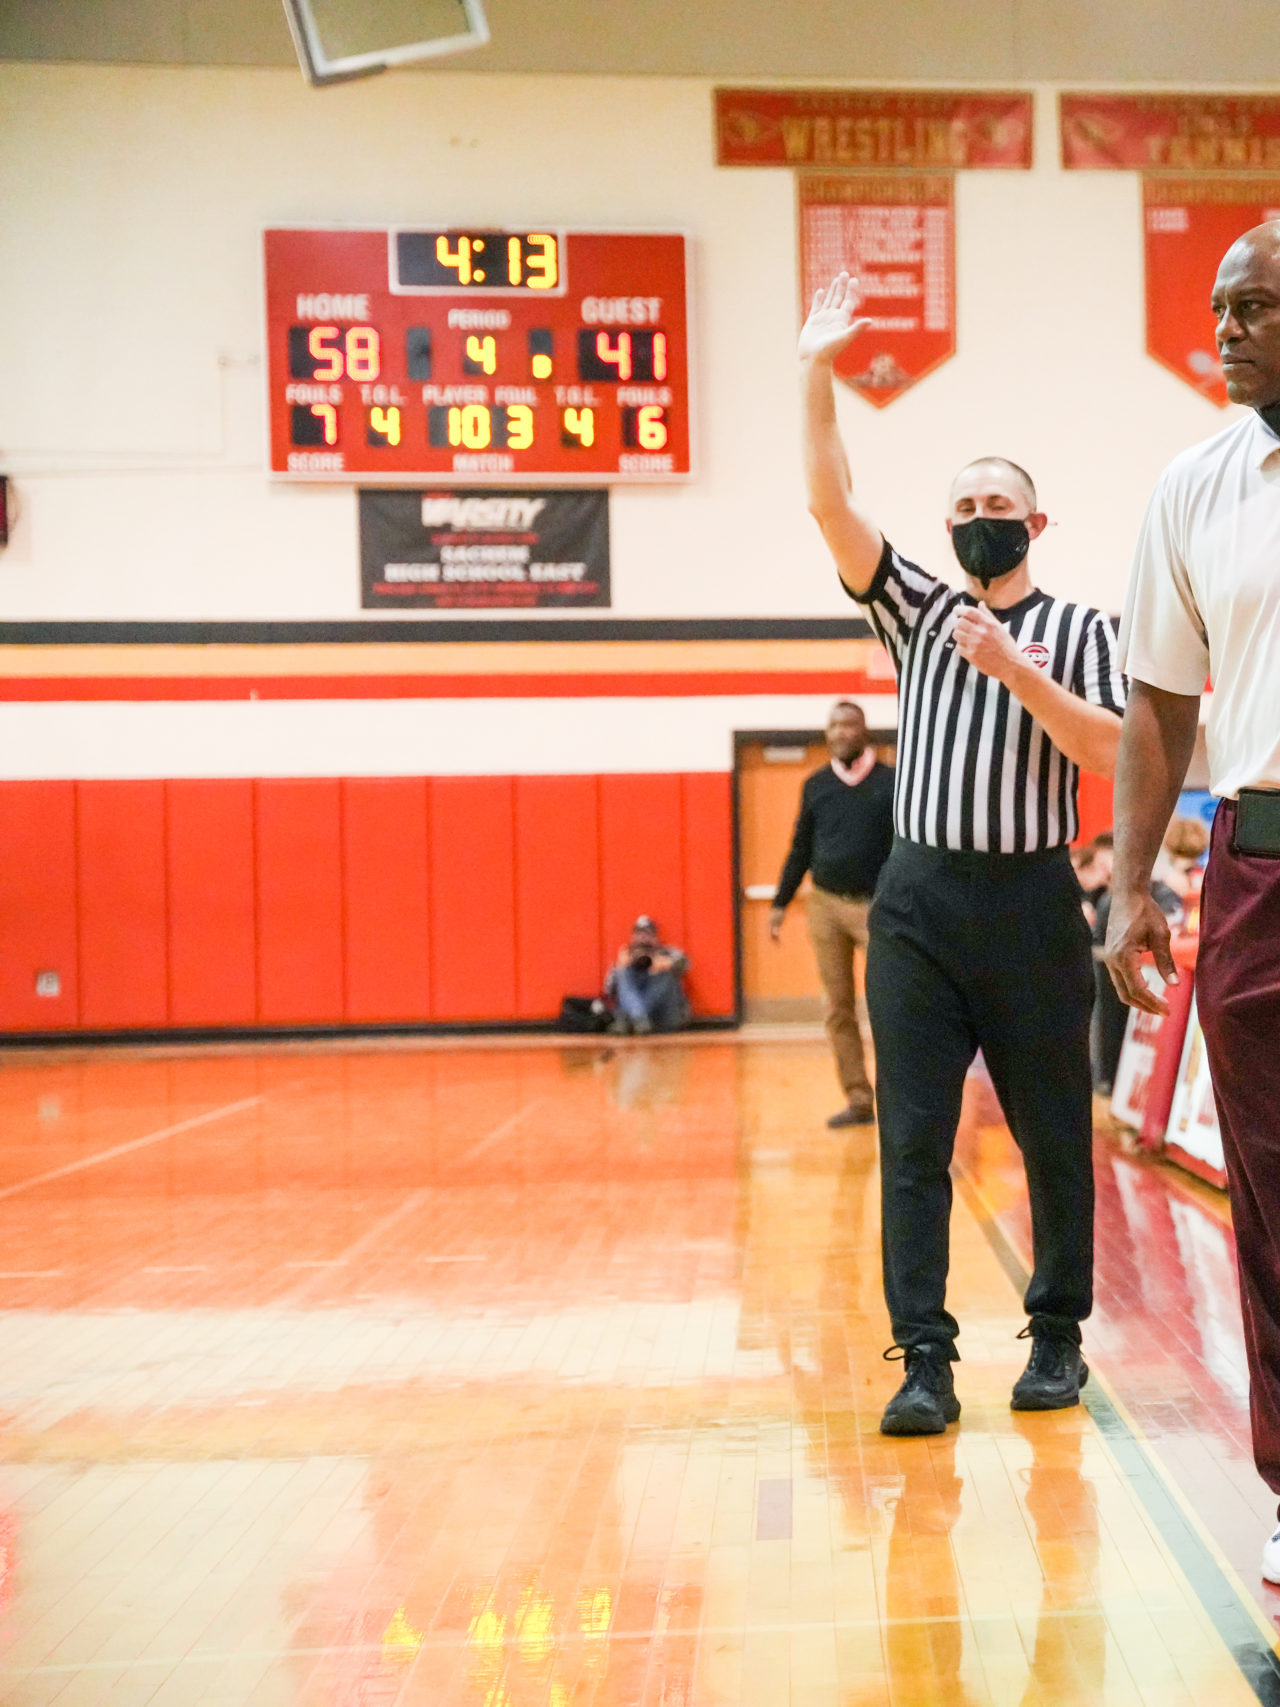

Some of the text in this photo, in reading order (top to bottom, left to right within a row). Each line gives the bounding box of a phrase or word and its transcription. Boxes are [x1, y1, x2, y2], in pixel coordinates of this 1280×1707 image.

[782, 116, 967, 161] WRESTLING
[436, 233, 558, 289] 4:13
[296, 294, 371, 322] HOME
[448, 308, 511, 330] PERIOD
[581, 296, 662, 325] GUEST
[308, 326, 381, 382] 58
[466, 335, 497, 375] 4
[596, 331, 667, 381] 41
[286, 384, 342, 405] FOULS
[422, 384, 538, 407] PLAYER FOUL
[616, 386, 673, 407] FOULS
[310, 402, 338, 445] 7
[370, 406, 401, 446] 4
[448, 404, 491, 449] 10
[506, 404, 533, 450] 3
[564, 407, 594, 447] 4
[637, 404, 668, 450] 6
[287, 452, 344, 472] SCORE
[453, 453, 514, 472] MATCH
[618, 453, 674, 472] SCORE
